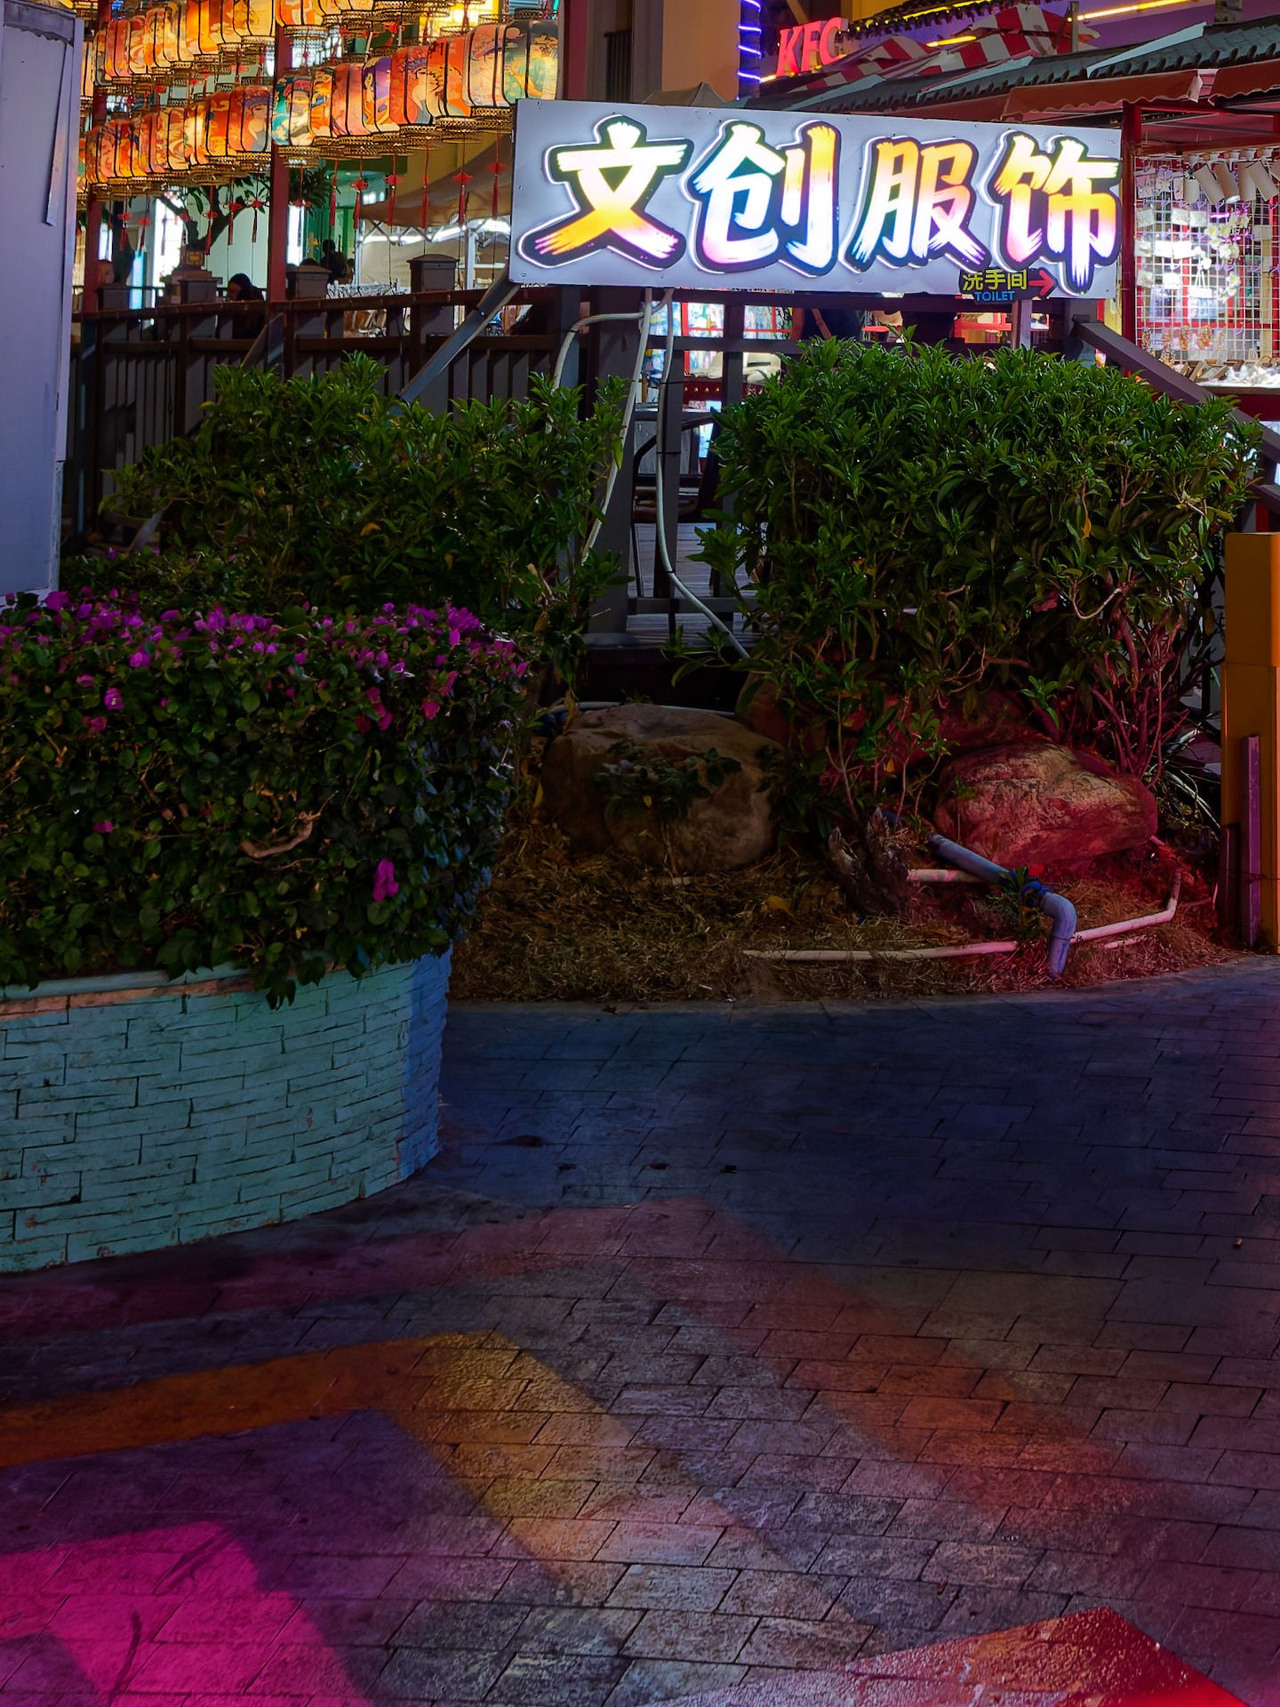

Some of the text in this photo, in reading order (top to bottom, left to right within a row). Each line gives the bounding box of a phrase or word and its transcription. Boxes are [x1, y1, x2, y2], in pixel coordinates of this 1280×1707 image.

[775, 16, 849, 78] KFC
[532, 114, 1122, 290] 文创服饰
[962, 268, 1028, 291] 洗手间
[974, 290, 1016, 302] TOILET
